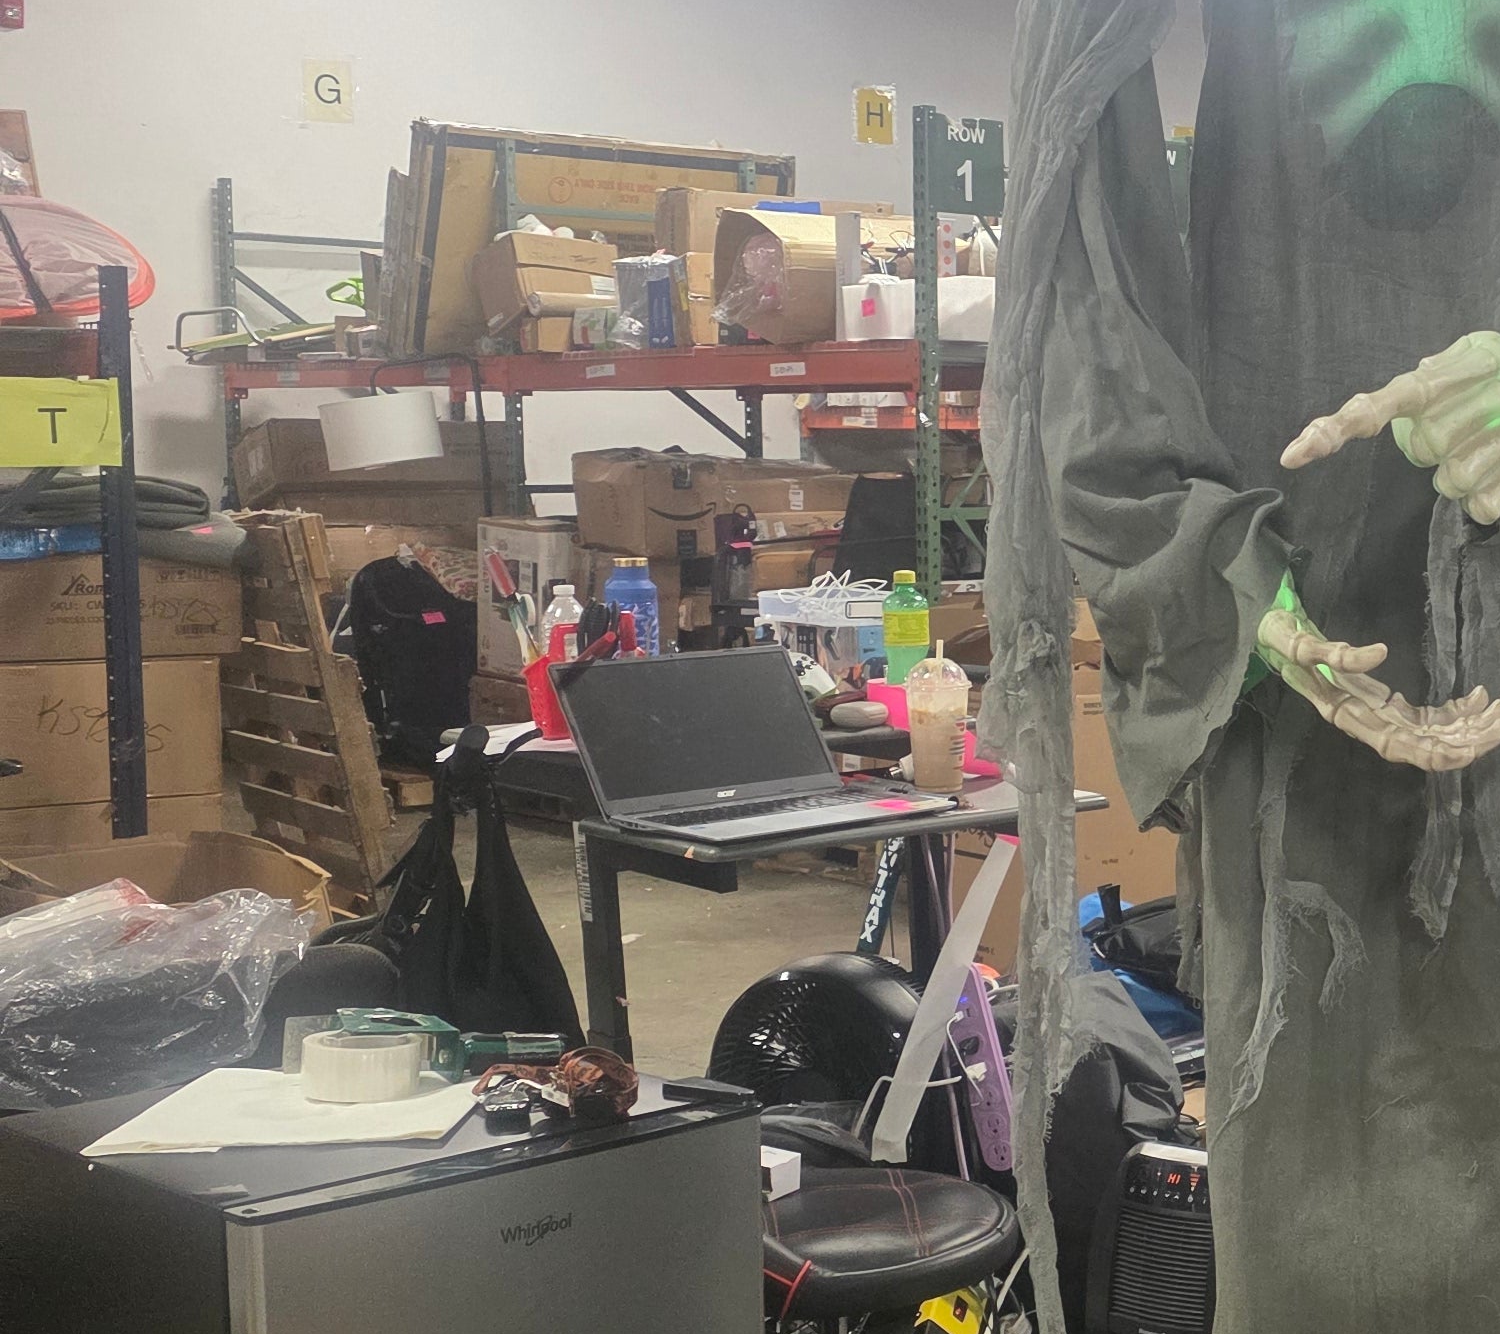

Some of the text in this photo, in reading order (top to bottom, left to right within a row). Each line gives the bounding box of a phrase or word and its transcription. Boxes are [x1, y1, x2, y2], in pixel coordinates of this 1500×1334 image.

[313, 74, 343, 107] G
[866, 100, 884, 128] H
[947, 125, 985, 144] ROW
[956, 159, 973, 202] 1
[38, 407, 68, 444] T
[1167, 1173, 1181, 1185] HI
[500, 1213, 573, 1246] Whirlpool
